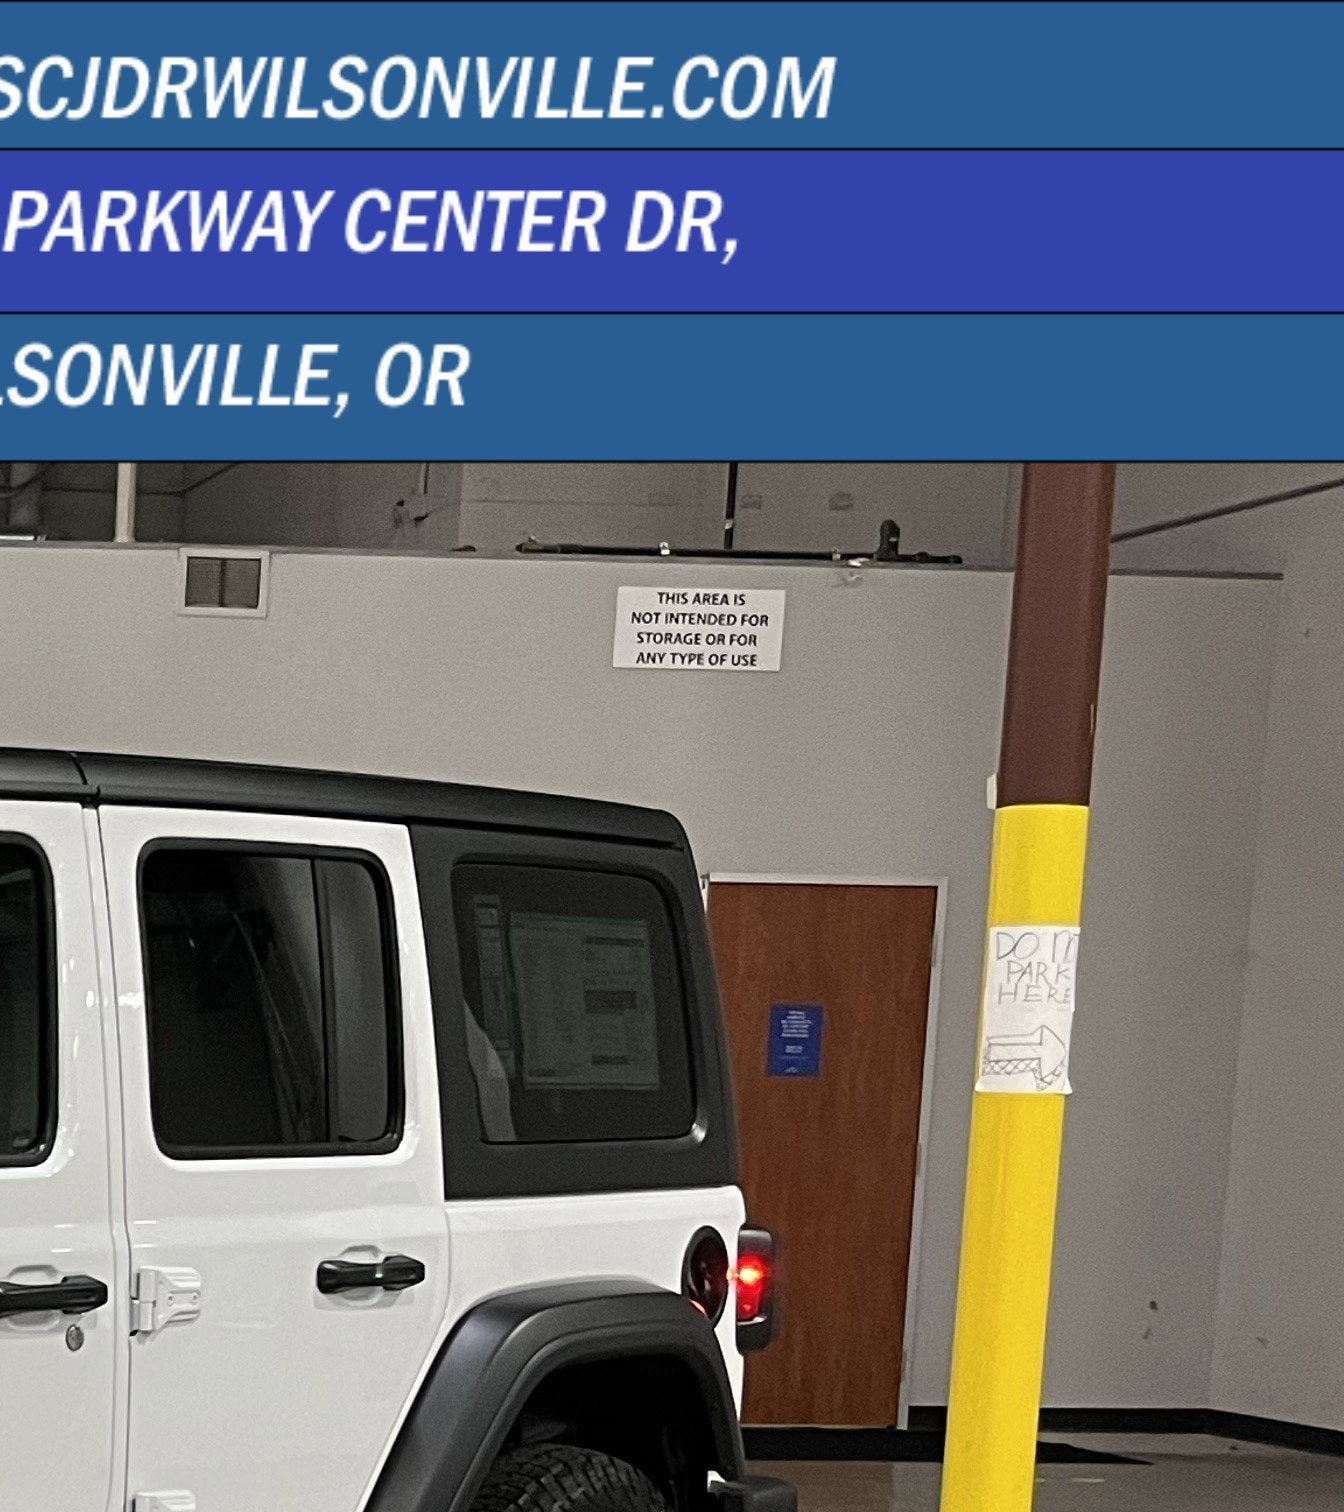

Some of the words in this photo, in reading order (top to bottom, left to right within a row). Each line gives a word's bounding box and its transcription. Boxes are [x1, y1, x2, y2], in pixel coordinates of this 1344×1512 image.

[657, 592, 688, 605] THIS
[692, 593, 729, 606] AREA
[733, 594, 746, 606] IS
[631, 612, 661, 625] NOT
[664, 612, 737, 626] INTENDED
[740, 614, 769, 627] FOR
[636, 632, 702, 645] STORAGE
[705, 633, 726, 646] OR
[729, 634, 757, 646] FOR
[636, 652, 666, 664] ANY
[670, 653, 704, 666] TYPE
[708, 654, 727, 666] OF
[731, 654, 757, 666] USE
[995, 931, 1040, 960] DO
[1007, 961, 1071, 985] PARK
[997, 982, 1071, 1005] HERE
